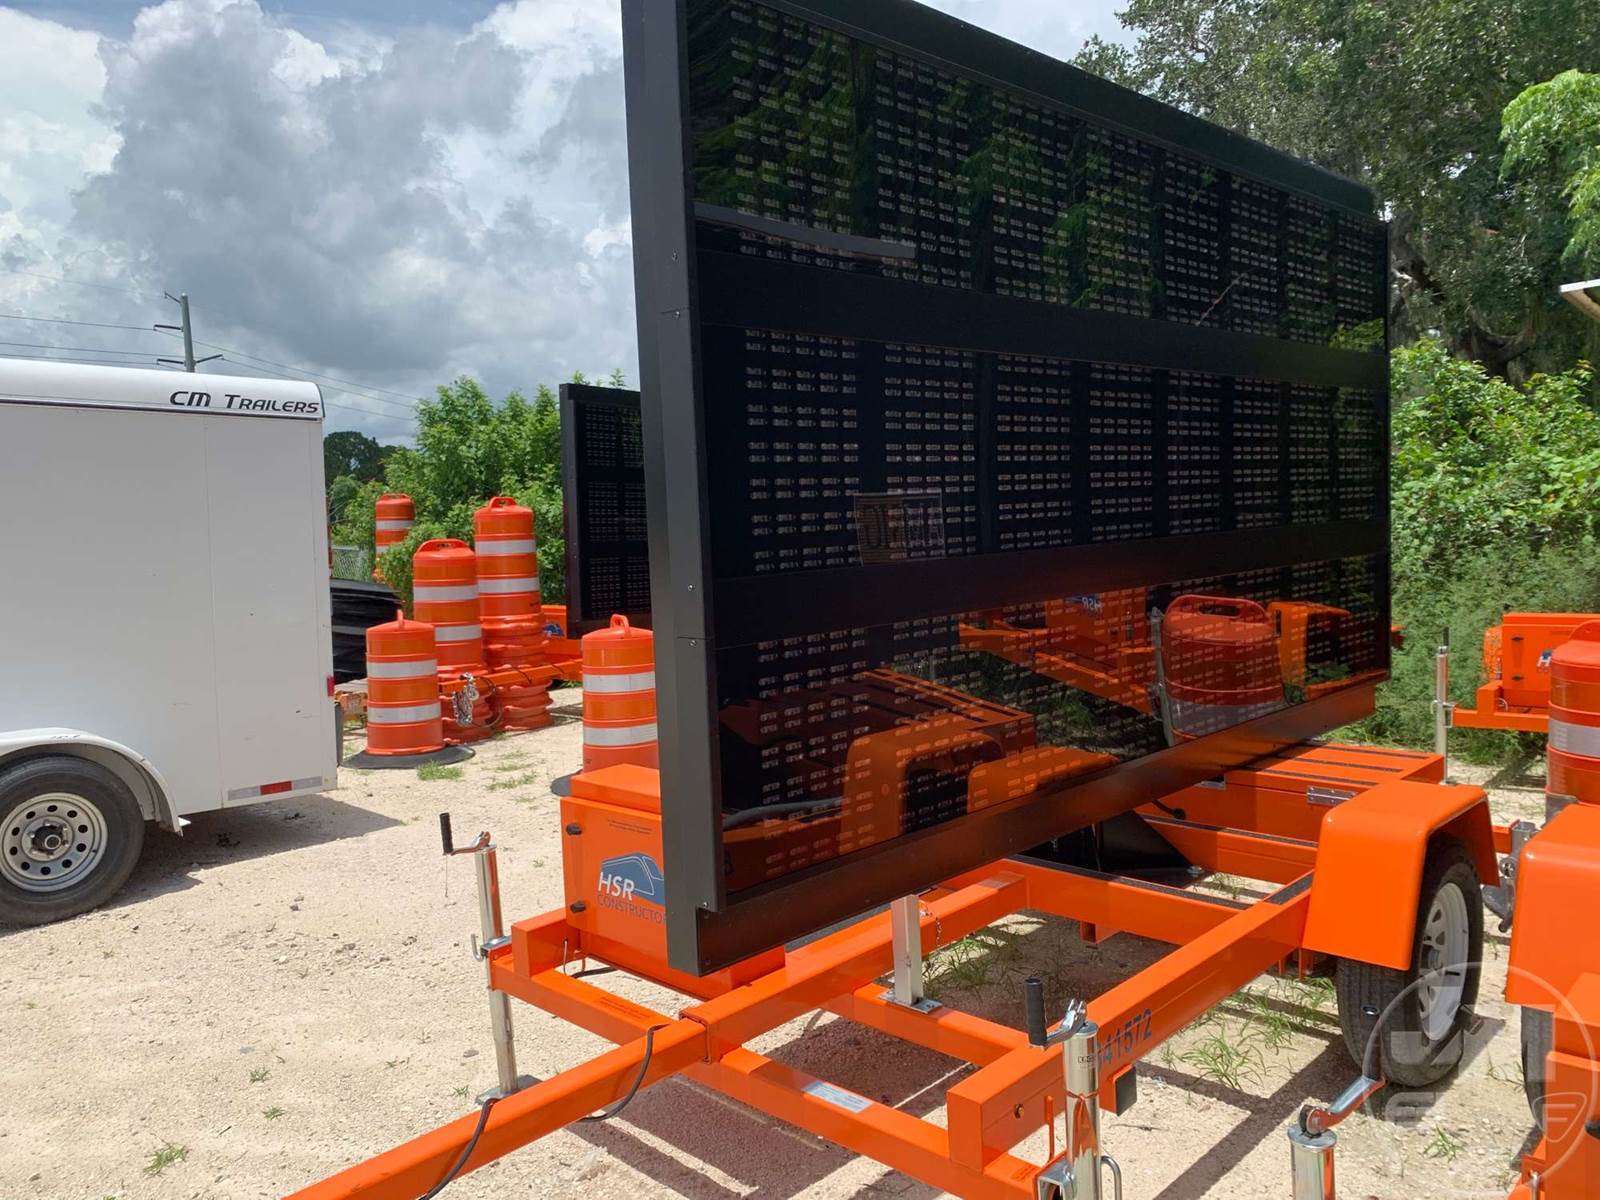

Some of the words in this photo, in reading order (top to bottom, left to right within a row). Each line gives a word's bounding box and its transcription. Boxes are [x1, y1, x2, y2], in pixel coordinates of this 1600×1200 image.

[169, 390, 212, 407] CM
[224, 393, 320, 414] TRAILERS
[597, 871, 635, 901] HSR
[1097, 1007, 1153, 1072] 41572
